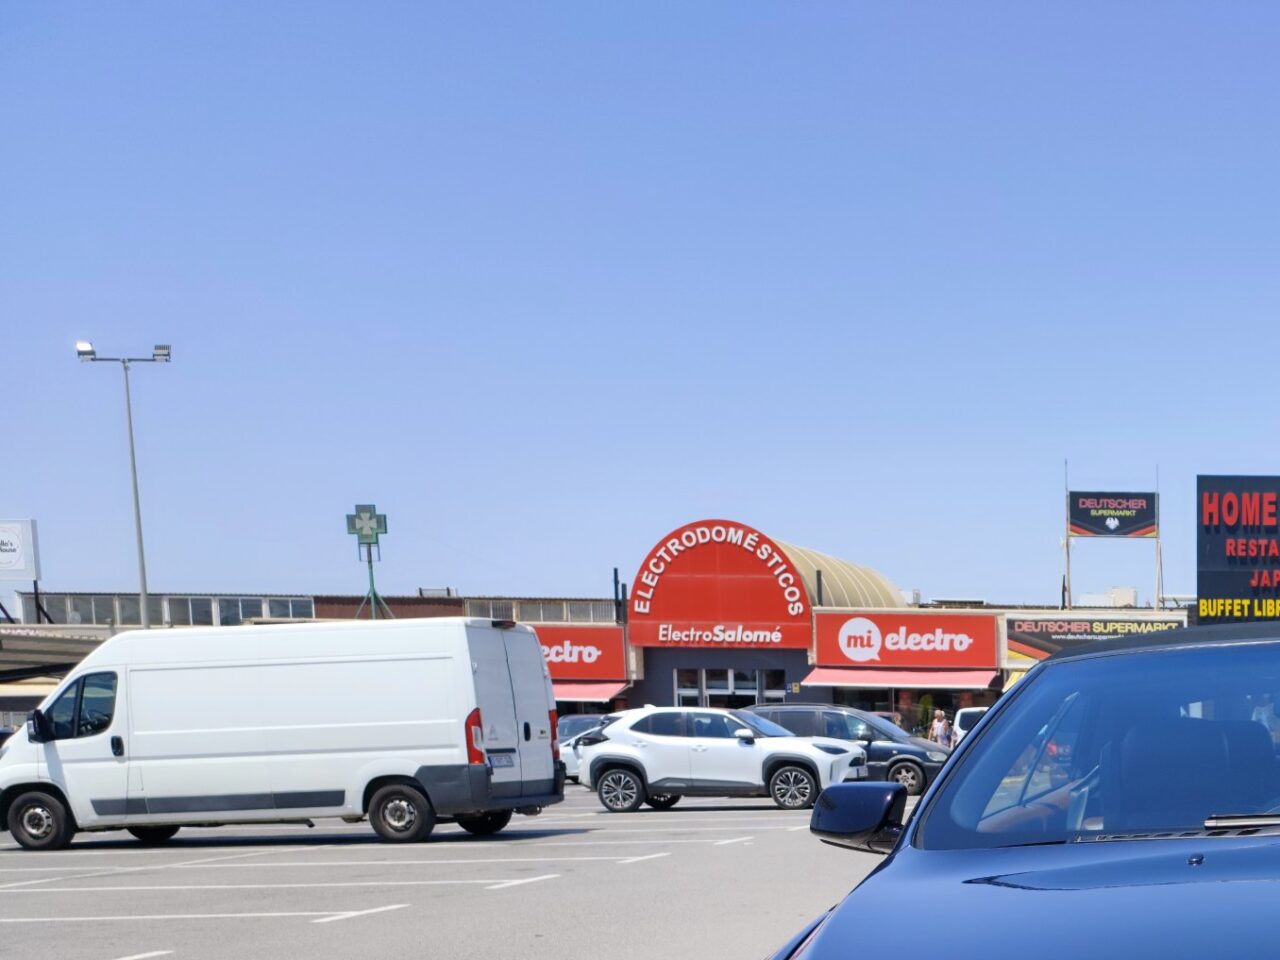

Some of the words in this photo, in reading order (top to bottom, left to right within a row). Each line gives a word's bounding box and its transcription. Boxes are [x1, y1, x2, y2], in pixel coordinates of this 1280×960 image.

[1079, 498, 1147, 509] DEUTSCHER
[1202, 492, 1277, 526] HOME
[634, 525, 804, 616] ELECTRODOMÉSTICOS
[1200, 599, 1250, 617] BUFFET
[658, 624, 782, 643] ElectroSalomé
[1014, 622, 1091, 632] DEUTSCHER
[846, 630, 873, 648] mi
[885, 626, 973, 651] electro
